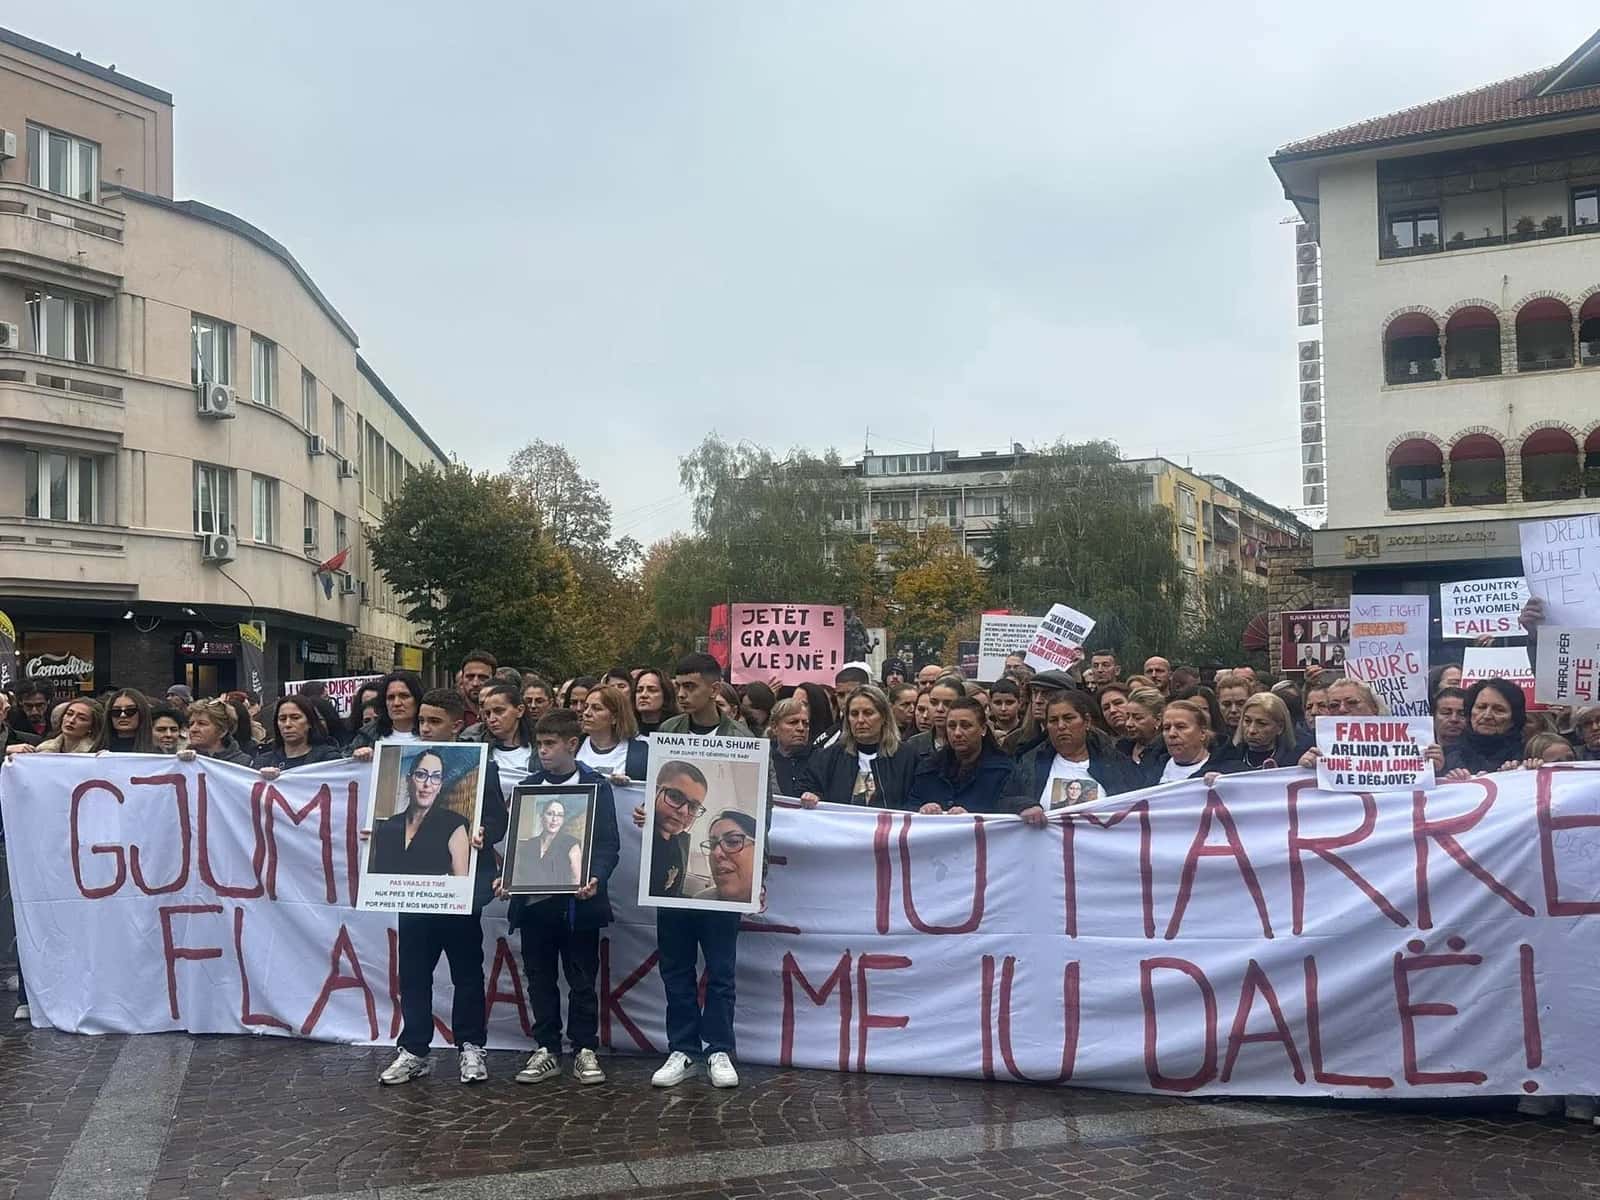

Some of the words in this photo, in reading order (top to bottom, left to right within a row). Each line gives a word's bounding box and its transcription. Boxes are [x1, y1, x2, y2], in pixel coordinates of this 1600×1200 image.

[1453, 585, 1461, 594] A
[1463, 580, 1519, 593] COUNTRY
[1453, 595, 1482, 605] THAT
[1486, 592, 1519, 602] FAILS
[741, 605, 810, 626] JETËT
[823, 611, 835, 627] E
[1356, 605, 1384, 617] WE
[1389, 604, 1425, 617] FIGHT
[1454, 606, 1471, 616] ITS
[1474, 603, 1520, 614] WOMEN
[1455, 617, 1510, 634] FAILS
[741, 629, 811, 648] GRAVE
[1394, 641, 1405, 653] A
[1572, 658, 1593, 702] JETË
[1335, 722, 1416, 745] FARUK,
[657, 736, 685, 746] NANA
[688, 738, 700, 747] TE
[702, 739, 724, 749] DUA
[726, 741, 761, 751] SHUME
[1331, 743, 1389, 757] ARLINDA
[1393, 744, 1420, 757] THA
[1356, 760, 1383, 772] JAM
[1335, 774, 1344, 785] A
[1347, 774, 1355, 785] E
[70, 771, 360, 907] GJUMI
